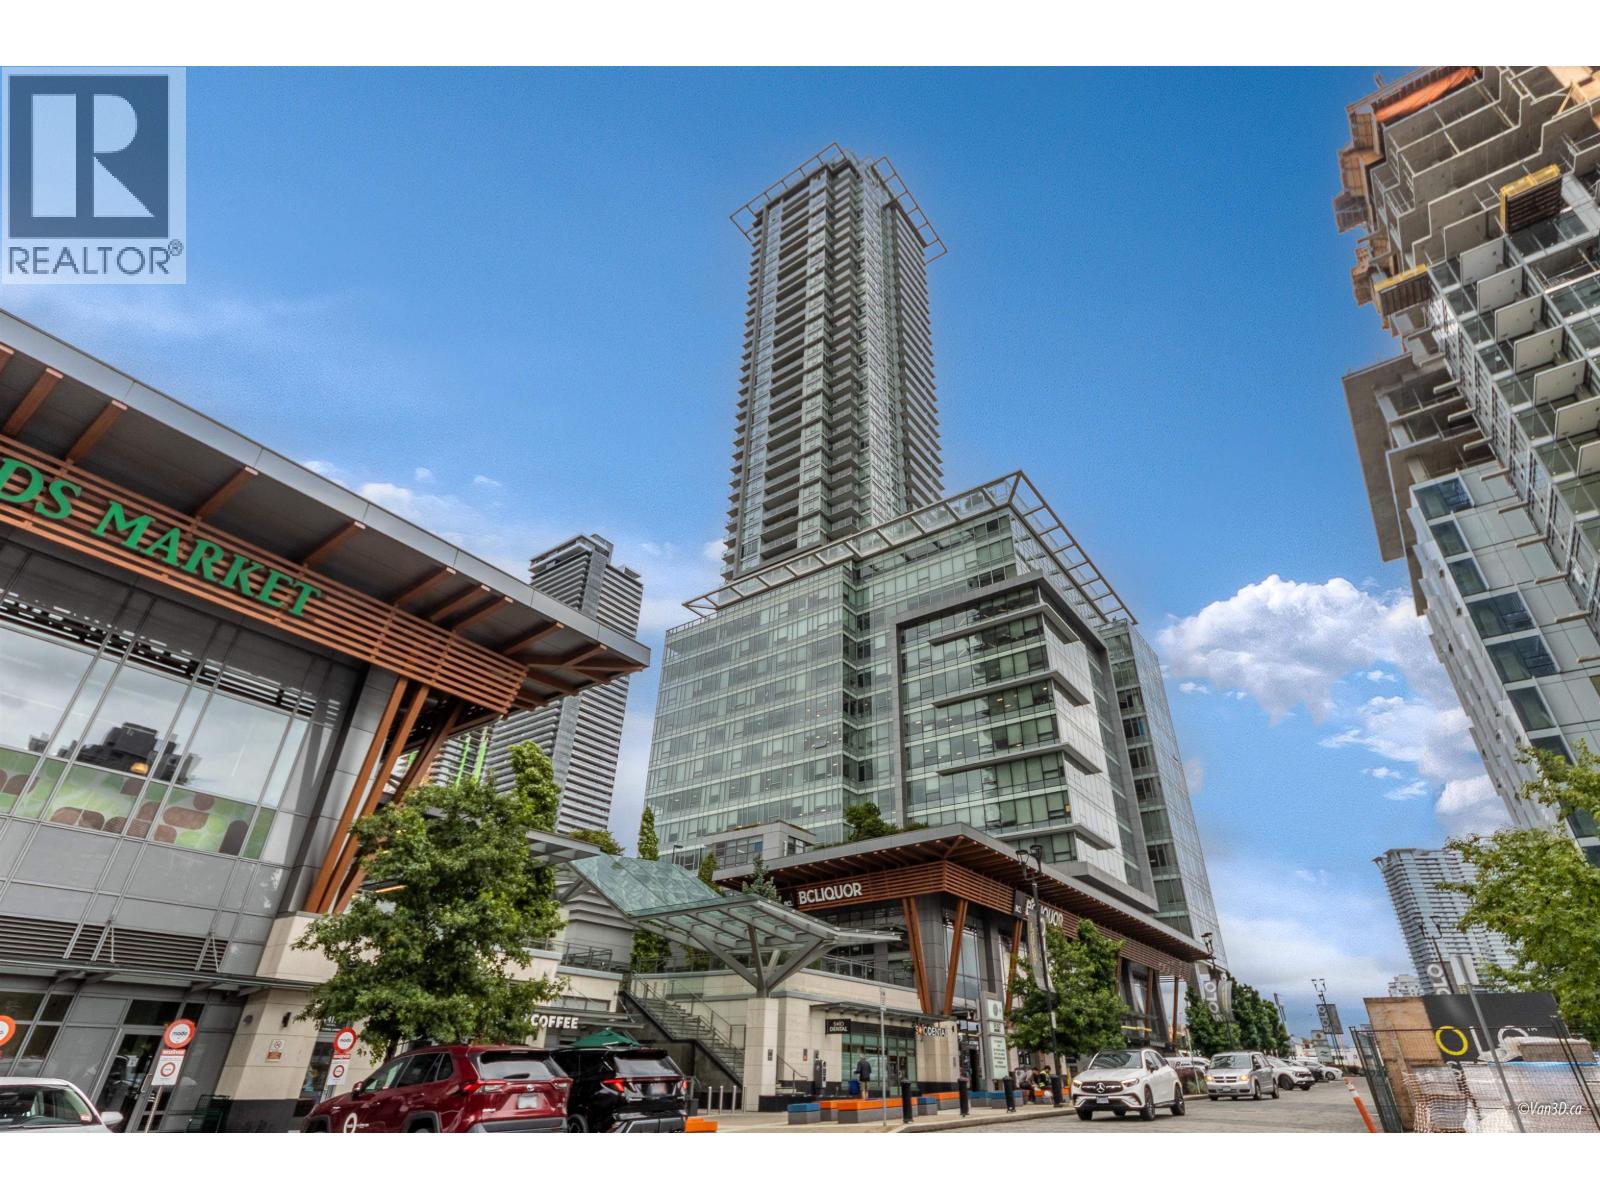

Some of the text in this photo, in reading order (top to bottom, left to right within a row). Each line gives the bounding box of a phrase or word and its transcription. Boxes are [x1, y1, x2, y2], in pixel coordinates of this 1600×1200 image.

[0, 457, 322, 617] DS MARKET
[530, 1014, 579, 1030] COFFEE
